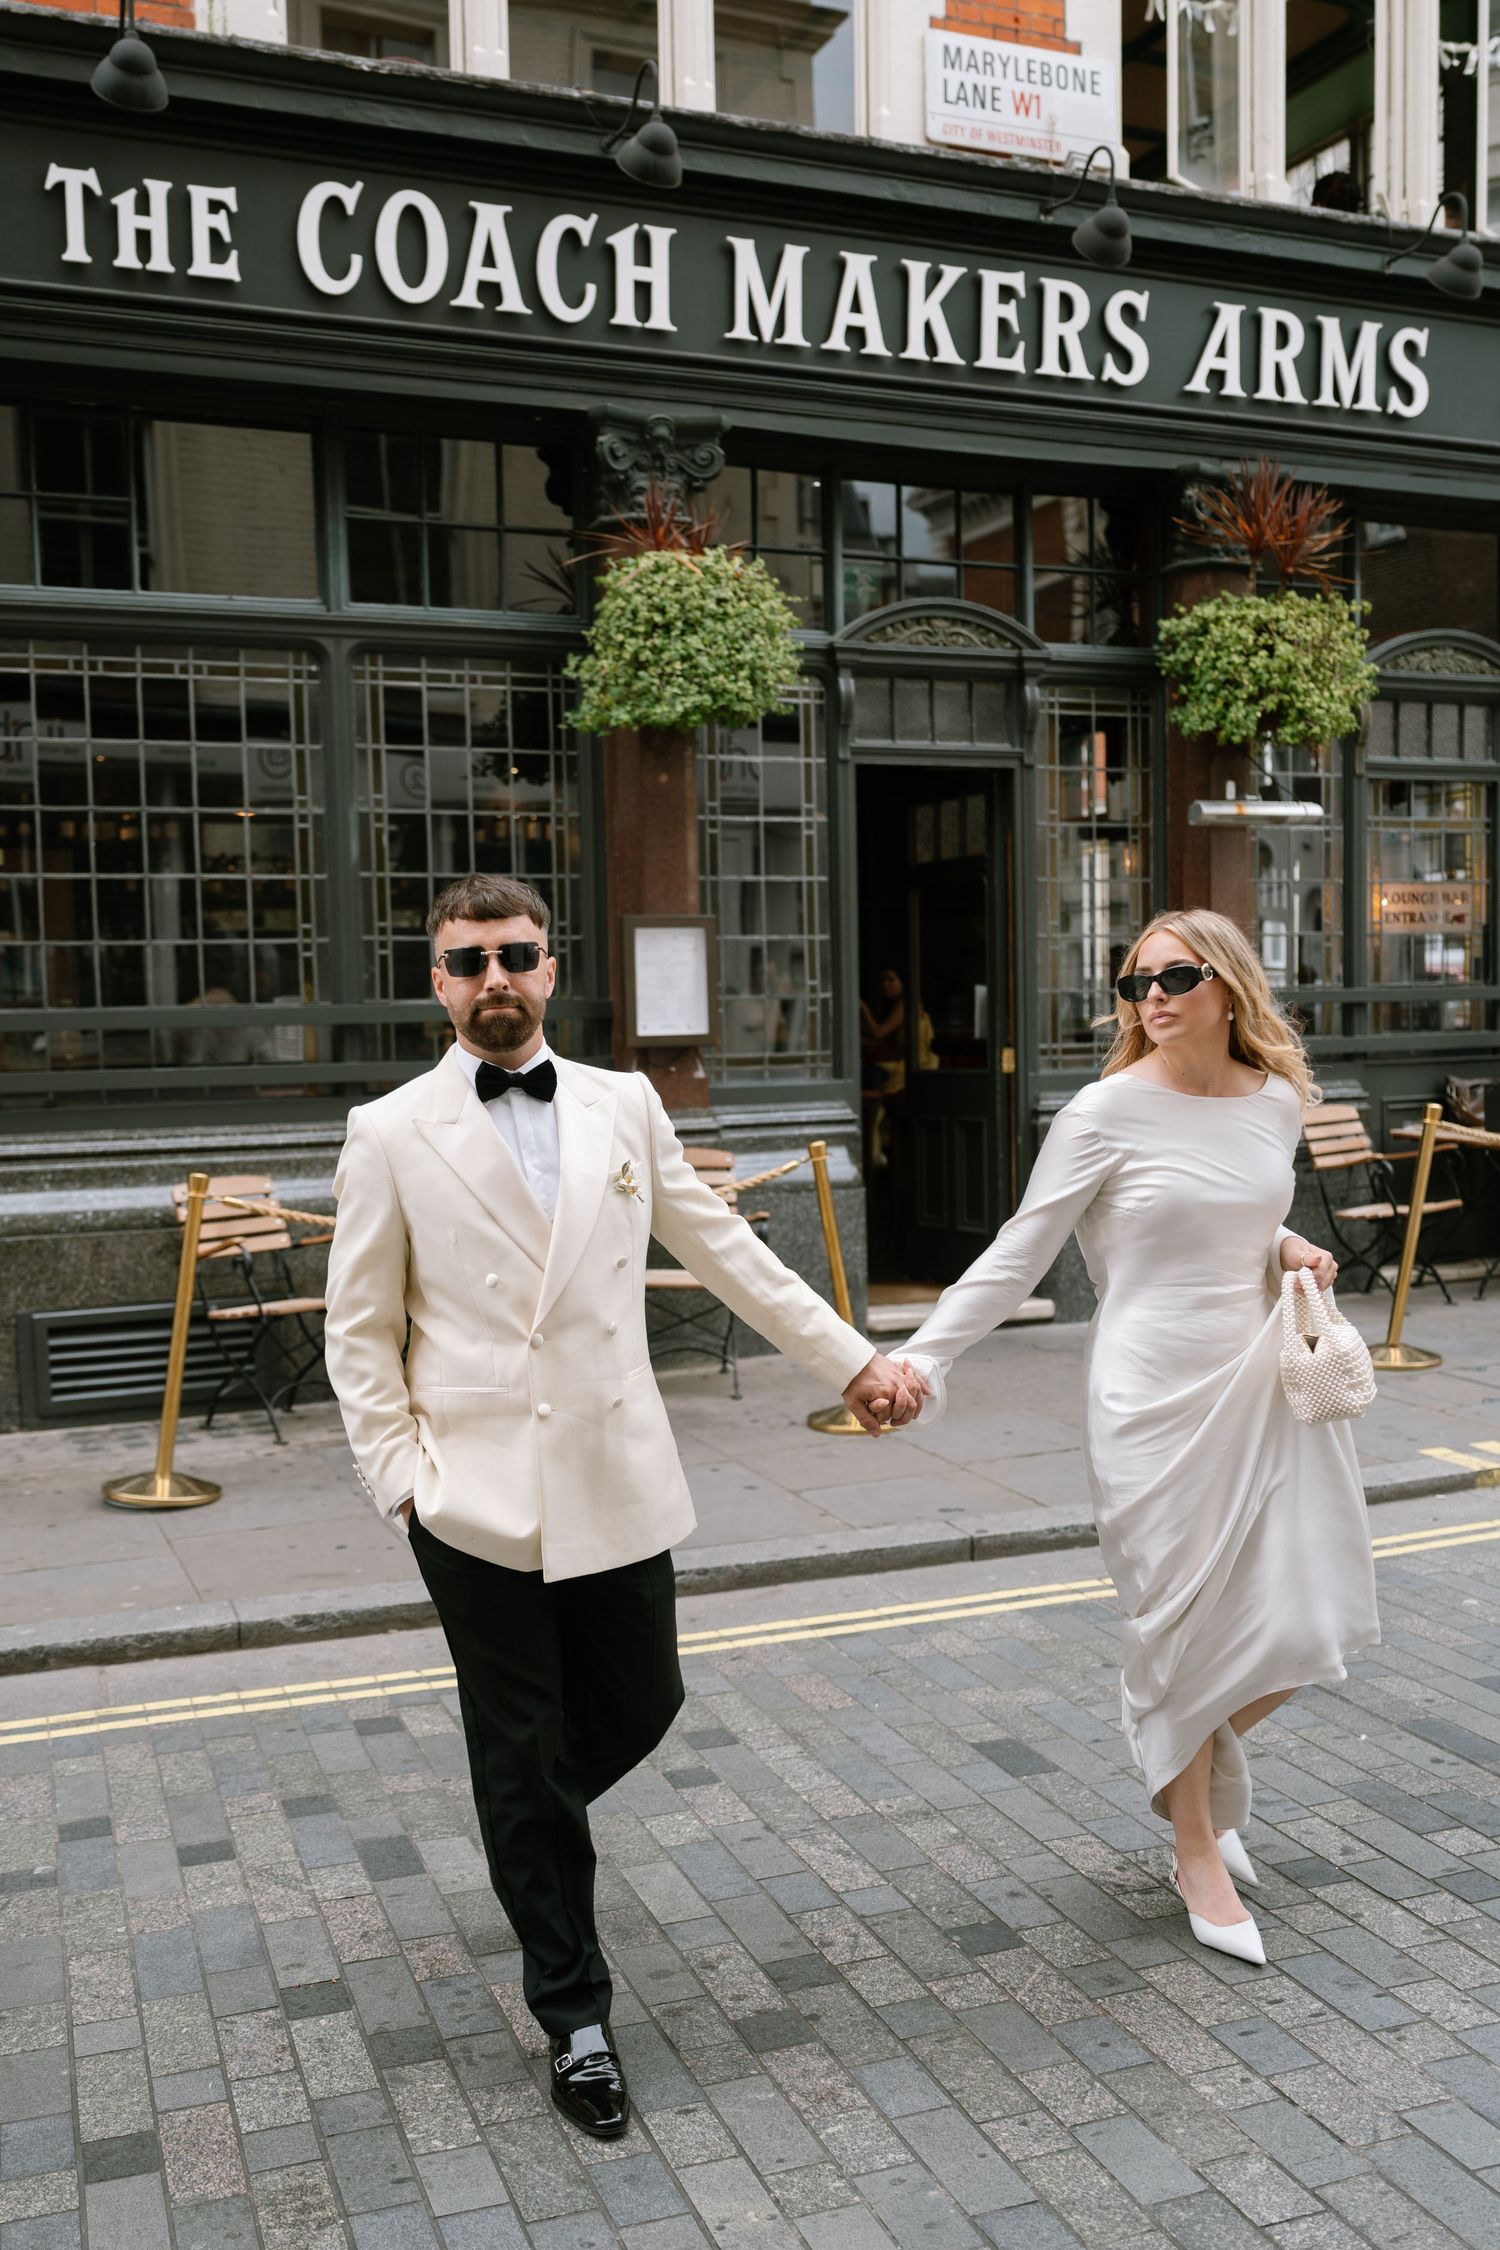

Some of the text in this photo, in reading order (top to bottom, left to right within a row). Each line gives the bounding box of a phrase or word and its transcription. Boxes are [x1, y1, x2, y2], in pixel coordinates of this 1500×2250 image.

[943, 44, 1102, 97] MARYLEBONE
[943, 78, 1041, 120] LANE W1
[943, 123, 1063, 153] CITY OF WESTMINSTER
[44, 162, 1430, 419] THE COACH MAKERS ARMS
[1383, 891, 1438, 905] LOUNGE
